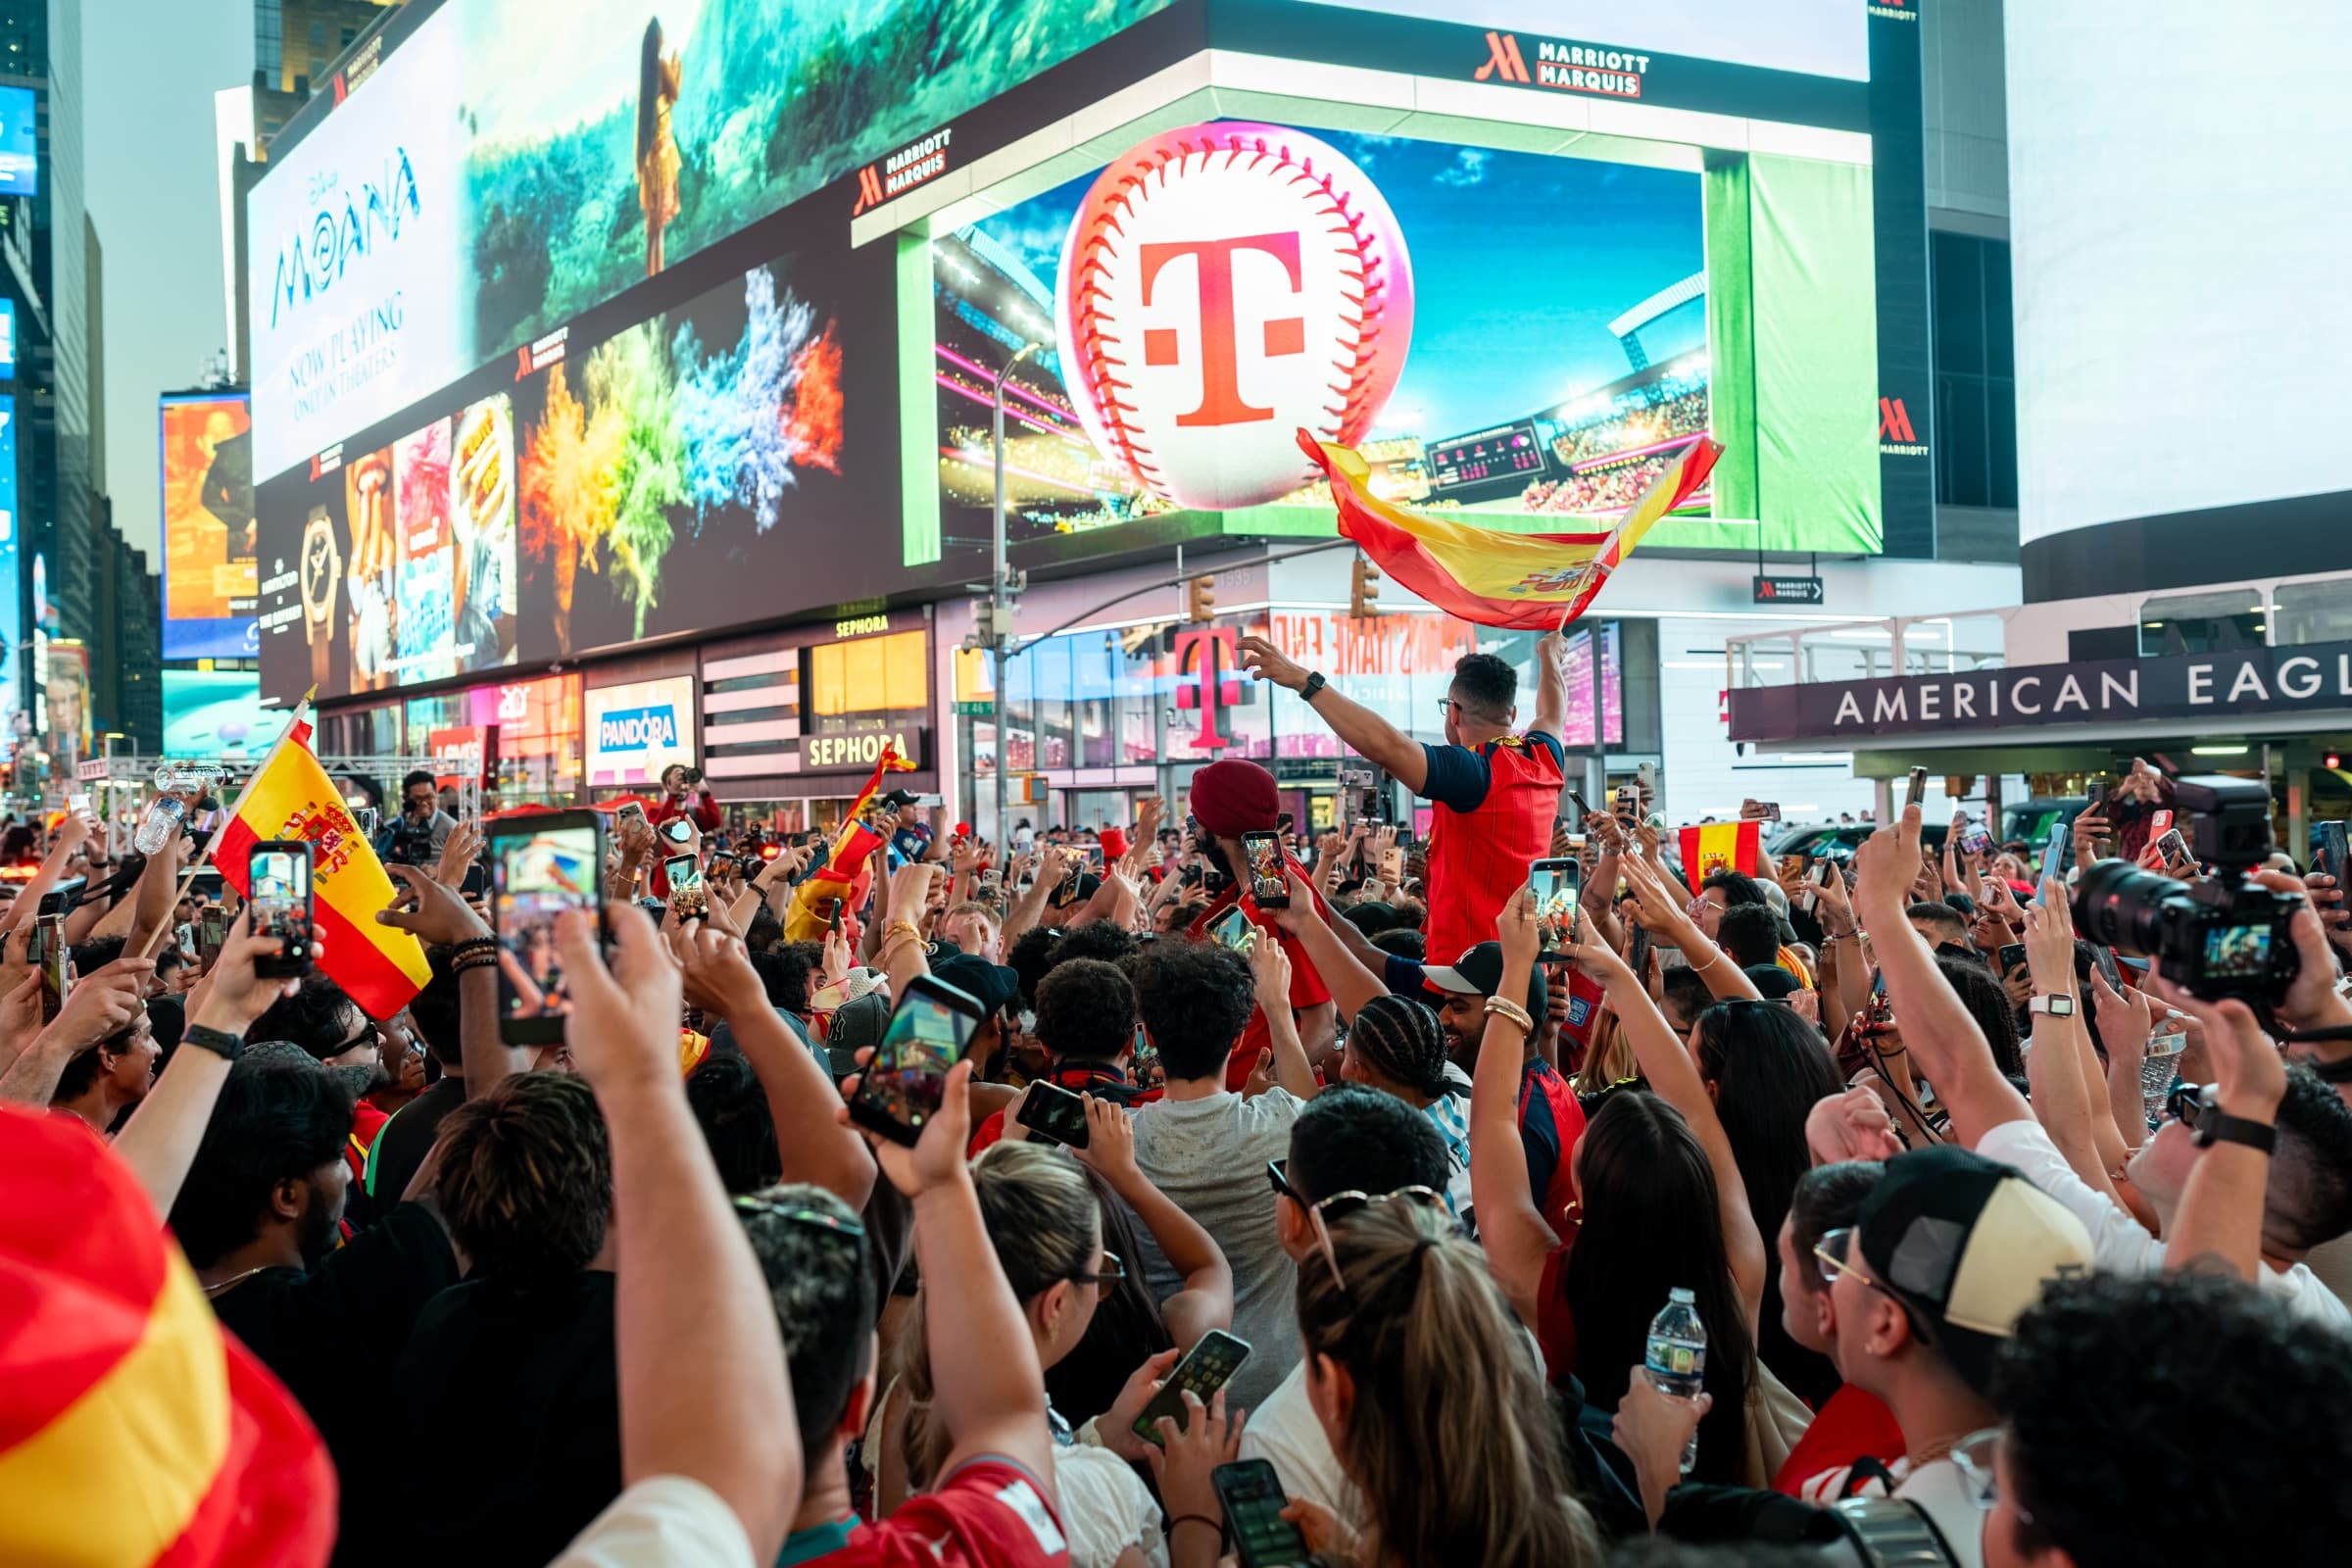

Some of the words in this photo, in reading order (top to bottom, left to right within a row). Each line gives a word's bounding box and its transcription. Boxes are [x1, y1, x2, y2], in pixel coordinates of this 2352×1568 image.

[1868, 6, 1917, 21] MARRIOTT
[1540, 42, 1649, 74] MARRIOTT
[1540, 65, 1638, 95] MARQUIS
[886, 128, 952, 174] MARRIOTT
[887, 153, 945, 194] MARQUIS
[272, 146, 420, 329] MOANA
[289, 346, 324, 394] NOW
[331, 291, 403, 368] PLAYING
[1140, 231, 1304, 426] T
[1880, 444, 1929, 456] MARRIOTT
[836, 615, 889, 638] SEPHORA
[1834, 670, 2139, 725] AMERICAN
[602, 715, 674, 748] PANDORA
